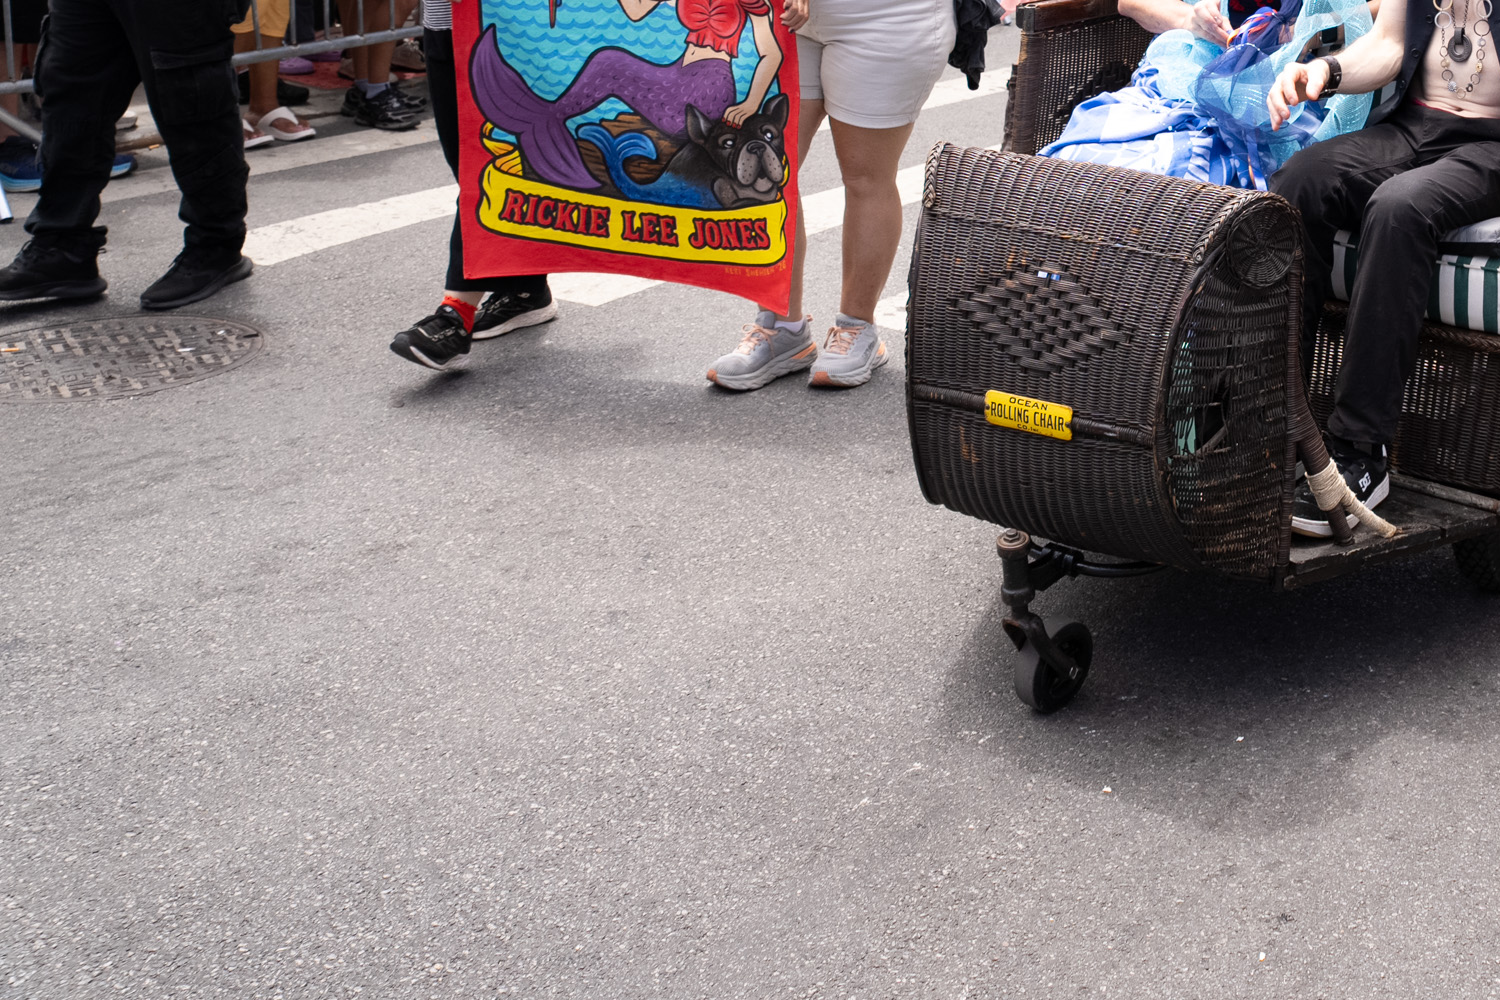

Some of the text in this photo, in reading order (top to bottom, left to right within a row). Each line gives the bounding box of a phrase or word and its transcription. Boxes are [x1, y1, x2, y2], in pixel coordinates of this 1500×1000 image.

[499, 188, 771, 251] RICKIE LEE JONES
[990, 401, 1065, 432] ROLLING CHAIR
[1009, 396, 1049, 411] OCEAN
